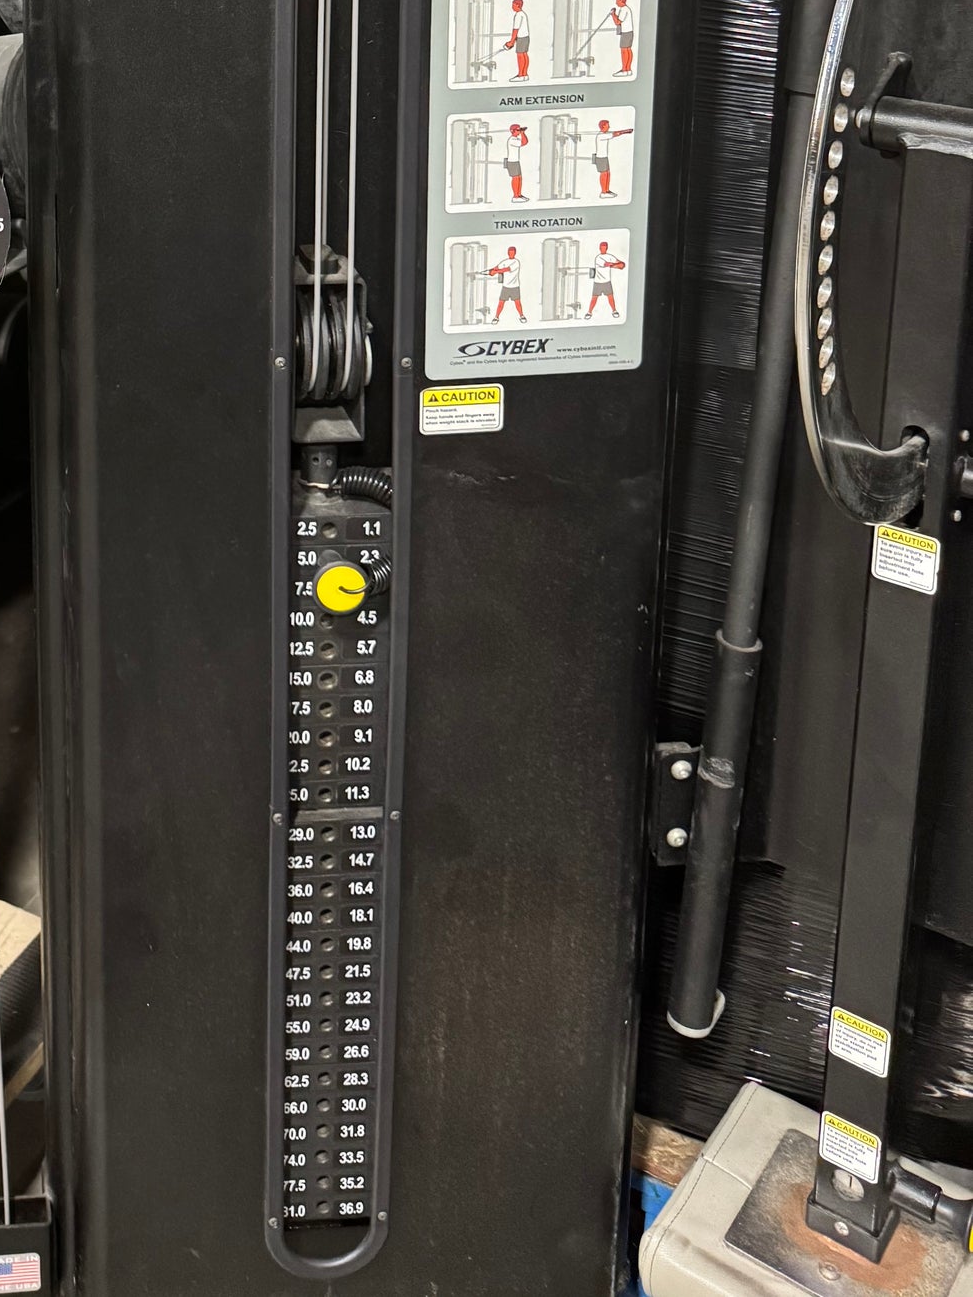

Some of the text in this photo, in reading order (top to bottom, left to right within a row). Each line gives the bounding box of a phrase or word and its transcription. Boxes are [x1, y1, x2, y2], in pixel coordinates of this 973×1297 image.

[499, 94, 585, 106] ARM EXTENSION
[494, 217, 583, 230] TRUNK ROTATION
[485, 338, 550, 356] CYBEX
[441, 391, 496, 402] CAUTION
[297, 521, 317, 536] 2.5
[363, 521, 381, 536] 1.1
[891, 532, 934, 550] CAUTION
[297, 550, 317, 566] 5.0
[360, 550, 380, 564] 2.3
[294, 581, 313, 596] 7.5
[290, 611, 315, 627] 10.0
[357, 610, 377, 625] 4.5
[290, 642, 314, 656] 12.5
[356, 640, 377, 655] 5.7
[354, 670, 375, 685] 6.8
[291, 701, 311, 715] 7.5
[353, 699, 373, 714] 8.0
[289, 730, 311, 745] 0.0
[354, 728, 373, 743] 9.1
[345, 756, 371, 772] 10.2
[289, 788, 309, 802] 5.0
[344, 786, 370, 801] 11.3
[288, 827, 315, 842] 29.0
[350, 825, 376, 840] 13.0
[287, 855, 314, 870] 32.5
[349, 853, 375, 867] 14.7
[287, 884, 313, 898] 36.0
[348, 881, 374, 896] 16.4
[287, 911, 313, 925] 40.0
[349, 908, 374, 922] 18.1
[286, 939, 311, 953] 44.0
[346, 937, 372, 951] 19.8
[285, 967, 311, 981] 47.5
[344, 964, 371, 979] 21.5
[286, 993, 311, 1007] 51.0
[345, 991, 371, 1005] 23.2
[285, 1020, 311, 1034] 55.0
[344, 1018, 371, 1032] 24.9
[846, 1017, 885, 1039] CAUTION
[285, 1047, 310, 1061] 59.0
[343, 1045, 369, 1059] 26.6
[284, 1074, 310, 1088] 62.5
[343, 1072, 369, 1086] 28.3
[284, 1101, 308, 1114] 66.0
[341, 1098, 367, 1112] 30.0
[283, 1128, 307, 1141] 70.0
[340, 1124, 365, 1138] 31.8
[836, 1123, 875, 1145] CAUTION
[339, 1150, 365, 1164] 33.5
[339, 1176, 365, 1190] 35.2
[339, 1202, 364, 1216] 36.9
[15, 1282, 38, 1290] USA
